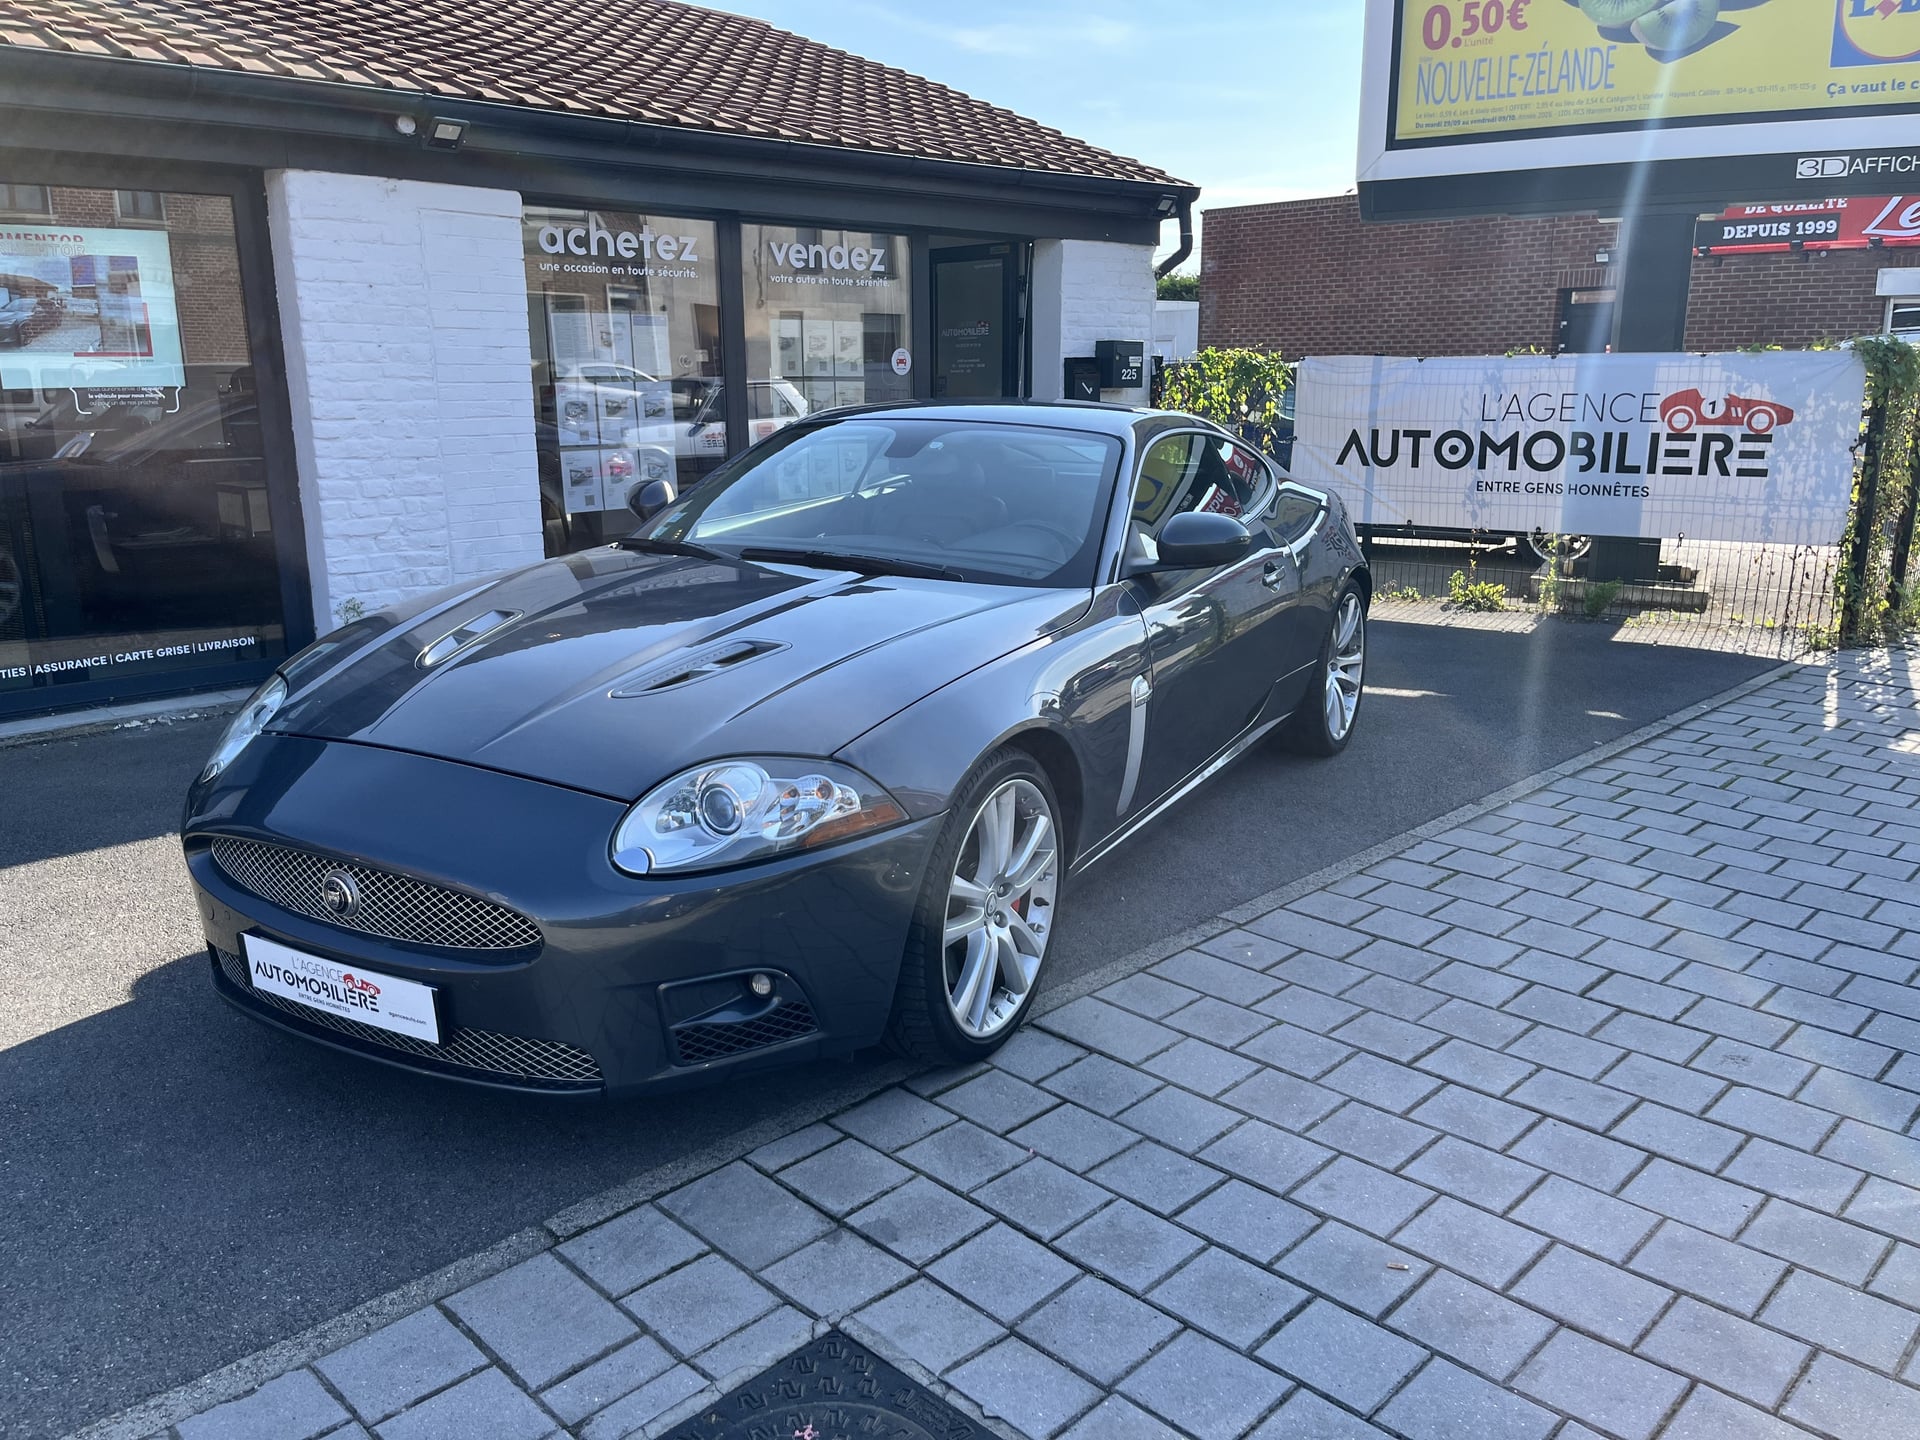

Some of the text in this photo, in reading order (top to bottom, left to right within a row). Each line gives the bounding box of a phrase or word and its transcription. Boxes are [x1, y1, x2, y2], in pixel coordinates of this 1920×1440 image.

[1464, 37, 1493, 47] L'unité
[1416, 41, 1617, 106] NOUVELLE-ZÉLANDE
[1826, 82, 1846, 98] Ça
[1851, 81, 1886, 94] vaut
[1891, 79, 1905, 91] le
[1798, 158, 1848, 177] 3D
[1723, 219, 1838, 240] DEPUIS 1999
[539, 224, 698, 262] achetez
[770, 238, 885, 272] vendez
[539, 263, 698, 279] une occasion en toute sécurité.
[770, 274, 890, 288] votre auto en toute sérénité.
[1121, 369, 1137, 380] 225
[1481, 392, 1659, 423] L'AGENCE
[1707, 399, 1718, 414] 1
[1476, 479, 1650, 499] ENTRE GENS HONNÊTES
[35, 655, 107, 675] ASSURANCE
[116, 649, 154, 664] CARTE
[157, 644, 191, 658] GRISE
[198, 635, 256, 653] LIVRAISON
[291, 956, 343, 983] L'AGENCE
[298, 992, 313, 1003] ENTRE
[313, 996, 326, 1007] GENS
